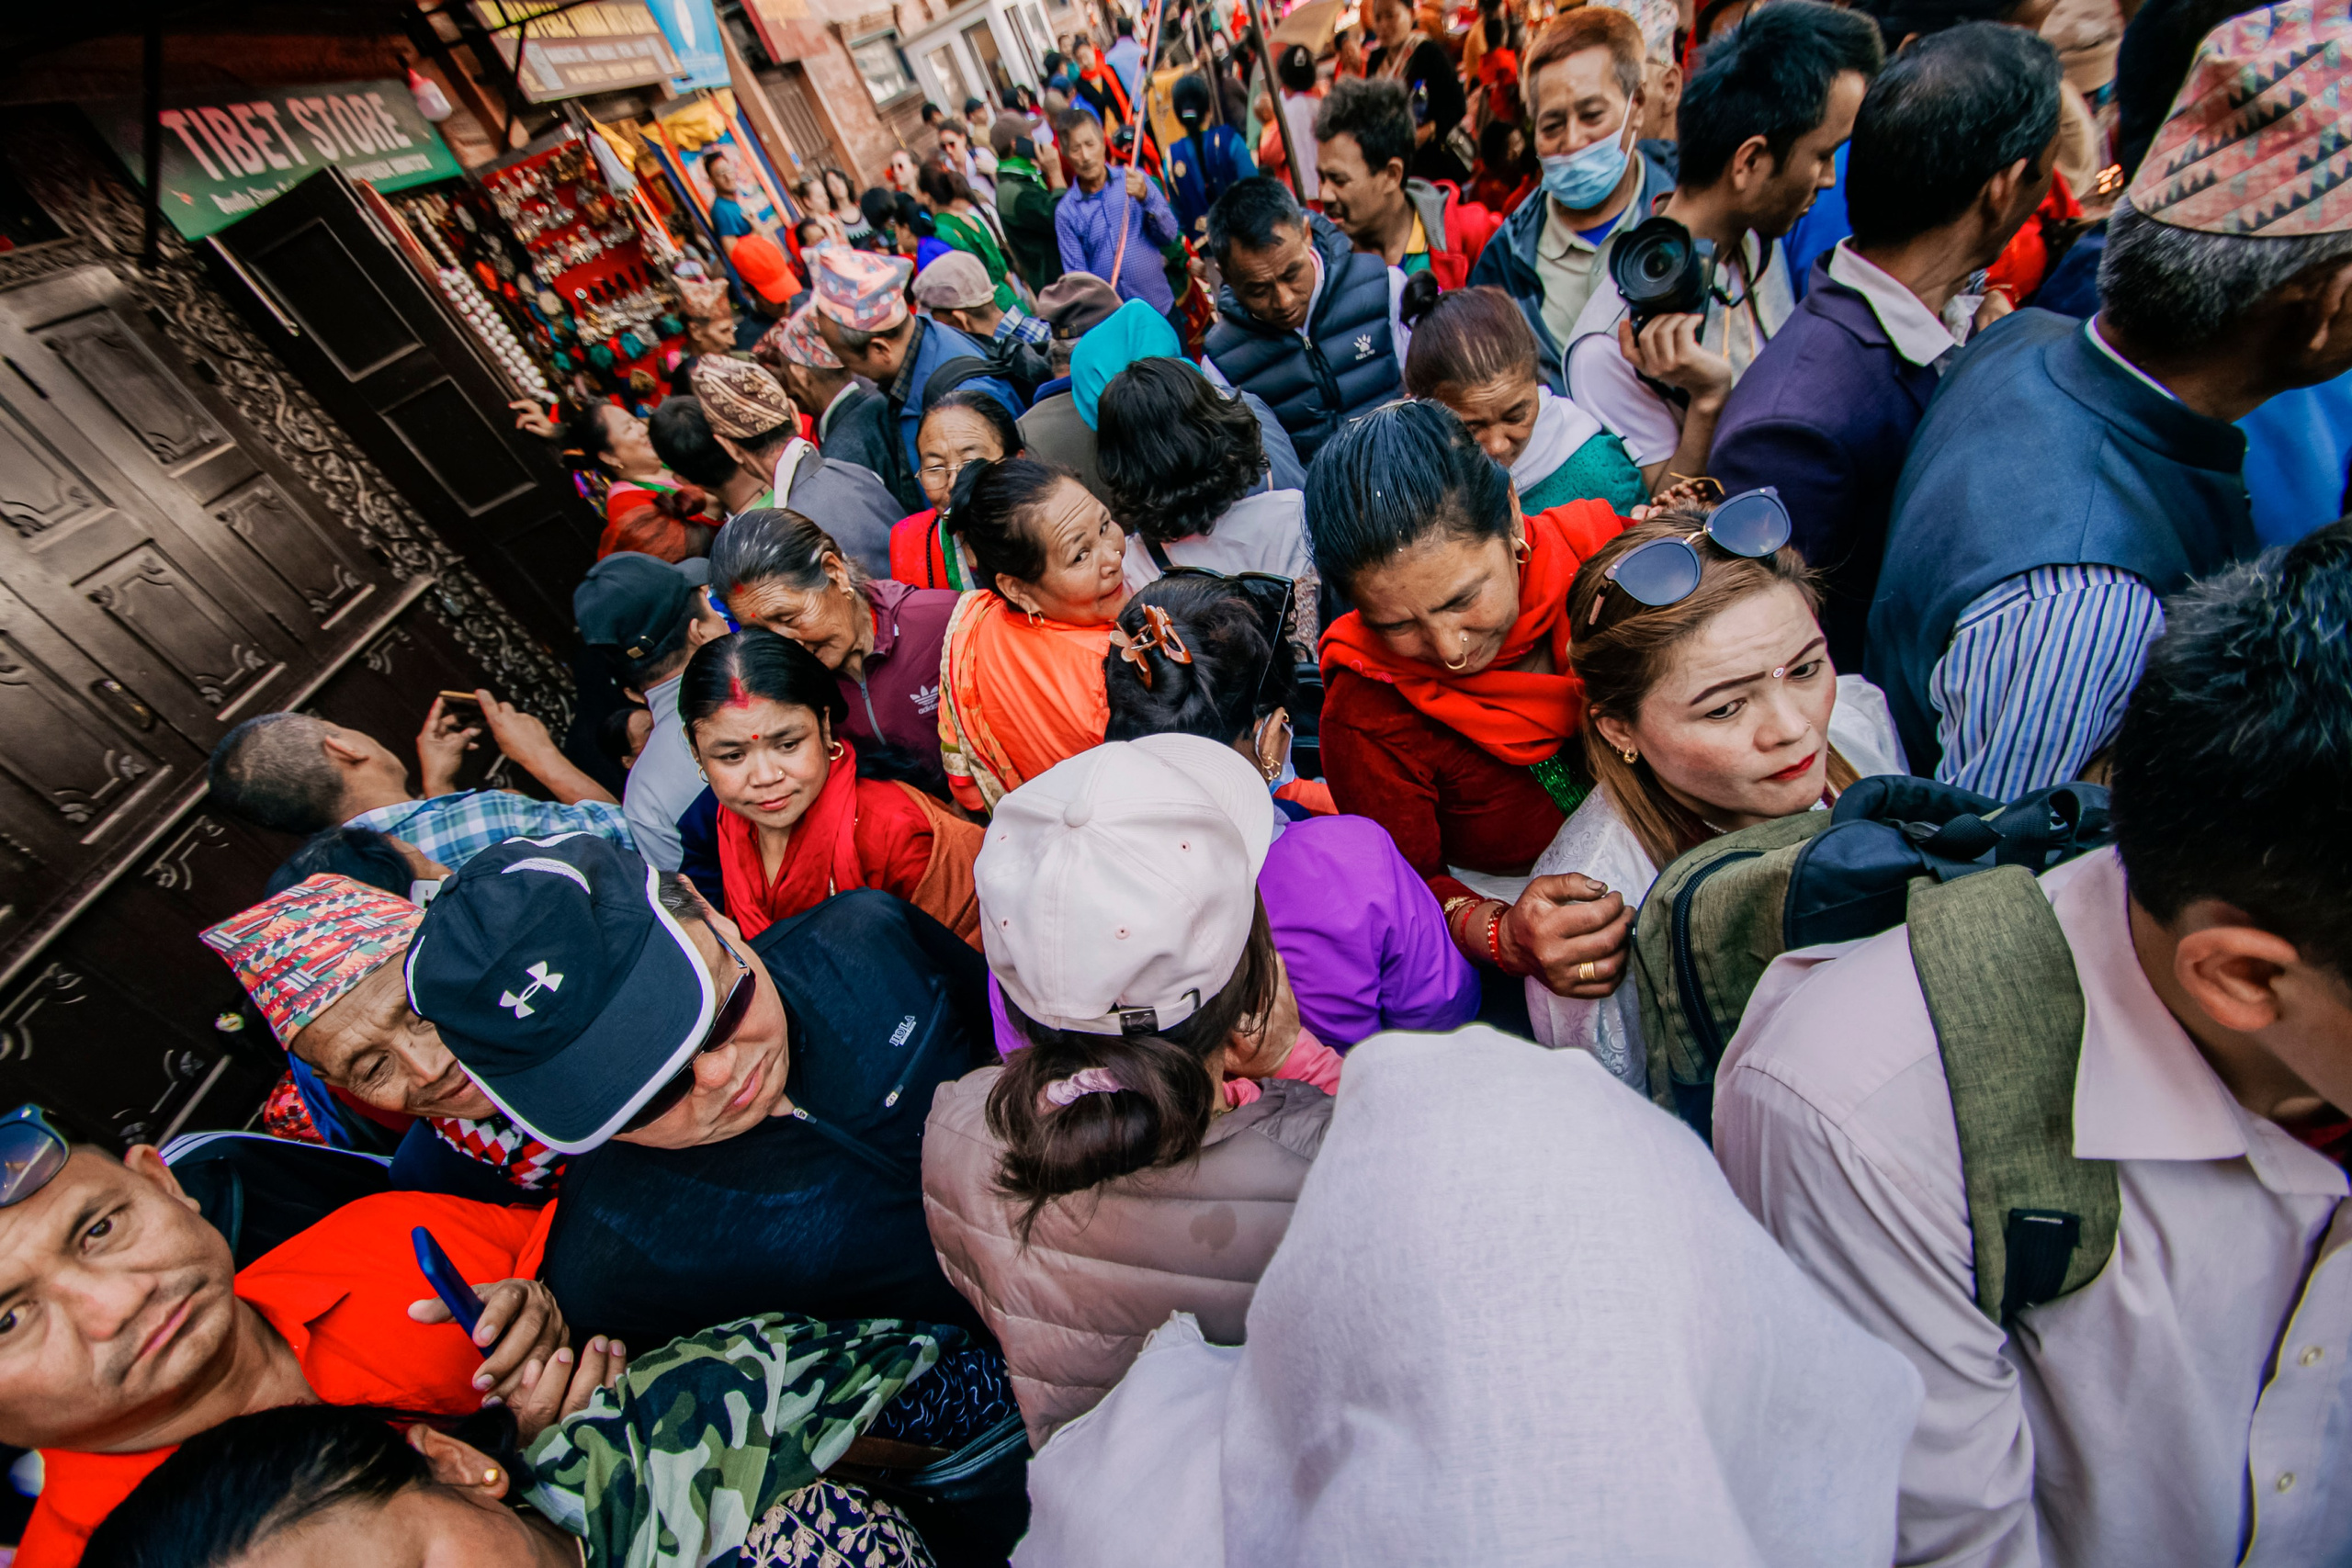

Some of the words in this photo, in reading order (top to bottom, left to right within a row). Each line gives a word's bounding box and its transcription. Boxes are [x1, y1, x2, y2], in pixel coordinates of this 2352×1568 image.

[159, 101, 309, 181] TIBET
[286, 93, 413, 162] STORE
[918, 703, 939, 714] adida
[889, 1015, 915, 1047] HOLA
